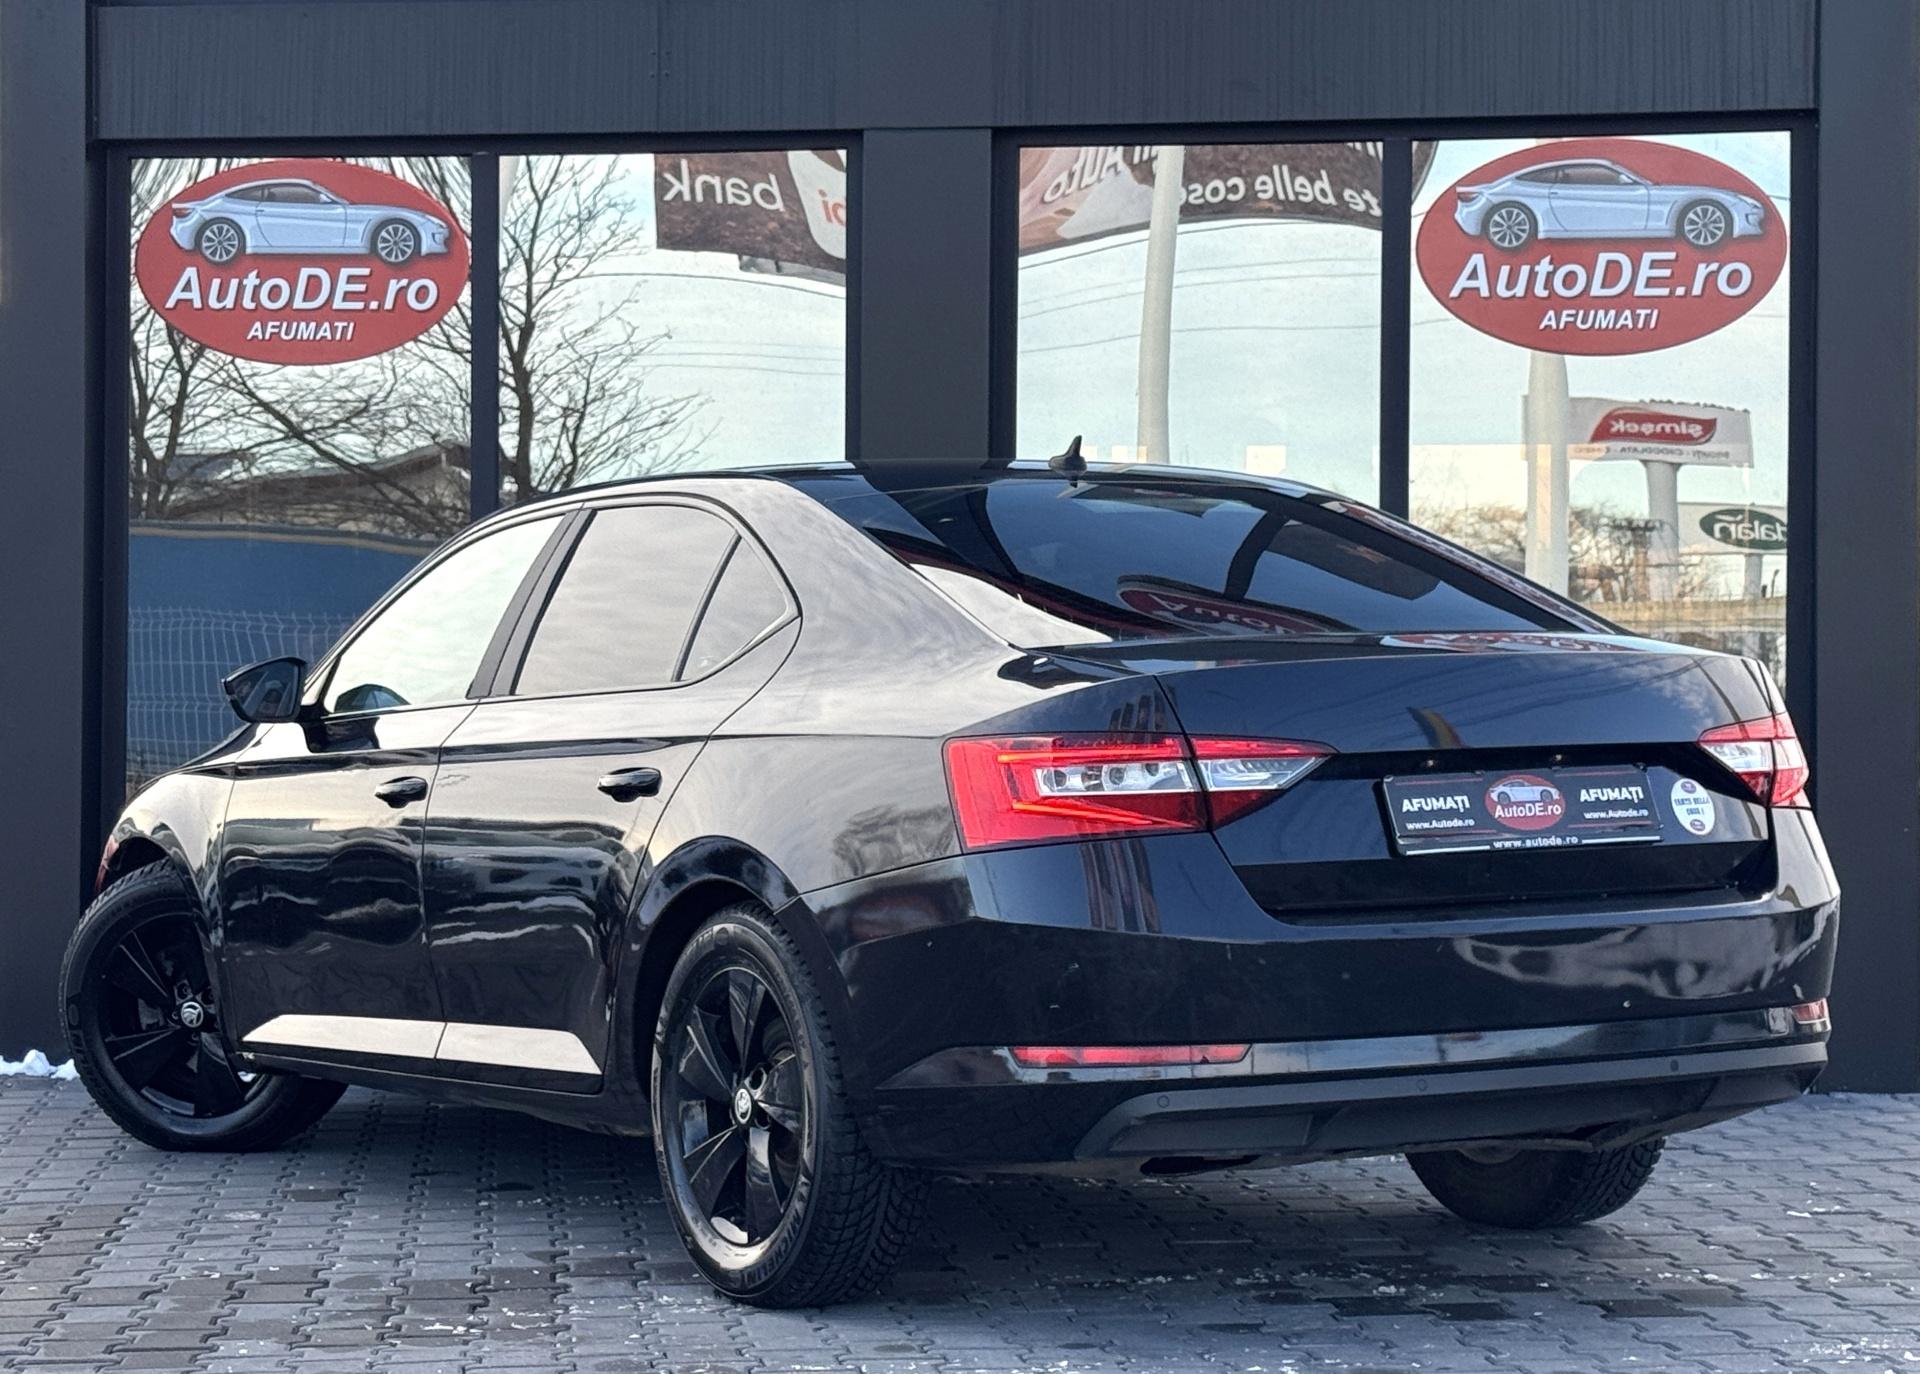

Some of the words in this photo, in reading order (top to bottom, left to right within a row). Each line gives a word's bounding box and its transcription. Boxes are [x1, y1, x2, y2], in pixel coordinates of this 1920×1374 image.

[1449, 251, 1753, 298] AutoDE.ro
[165, 266, 440, 311] AutoDE.ro
[1539, 307, 1658, 330] AFUMATI
[247, 321, 355, 341] AFUMATI
[1495, 802, 1562, 819] AutoDE.ro
[1584, 808, 1648, 820] www.Autode.ro
[1406, 818, 1475, 831] www.Autode.ro
[1493, 835, 1578, 849] www.autode.ro
